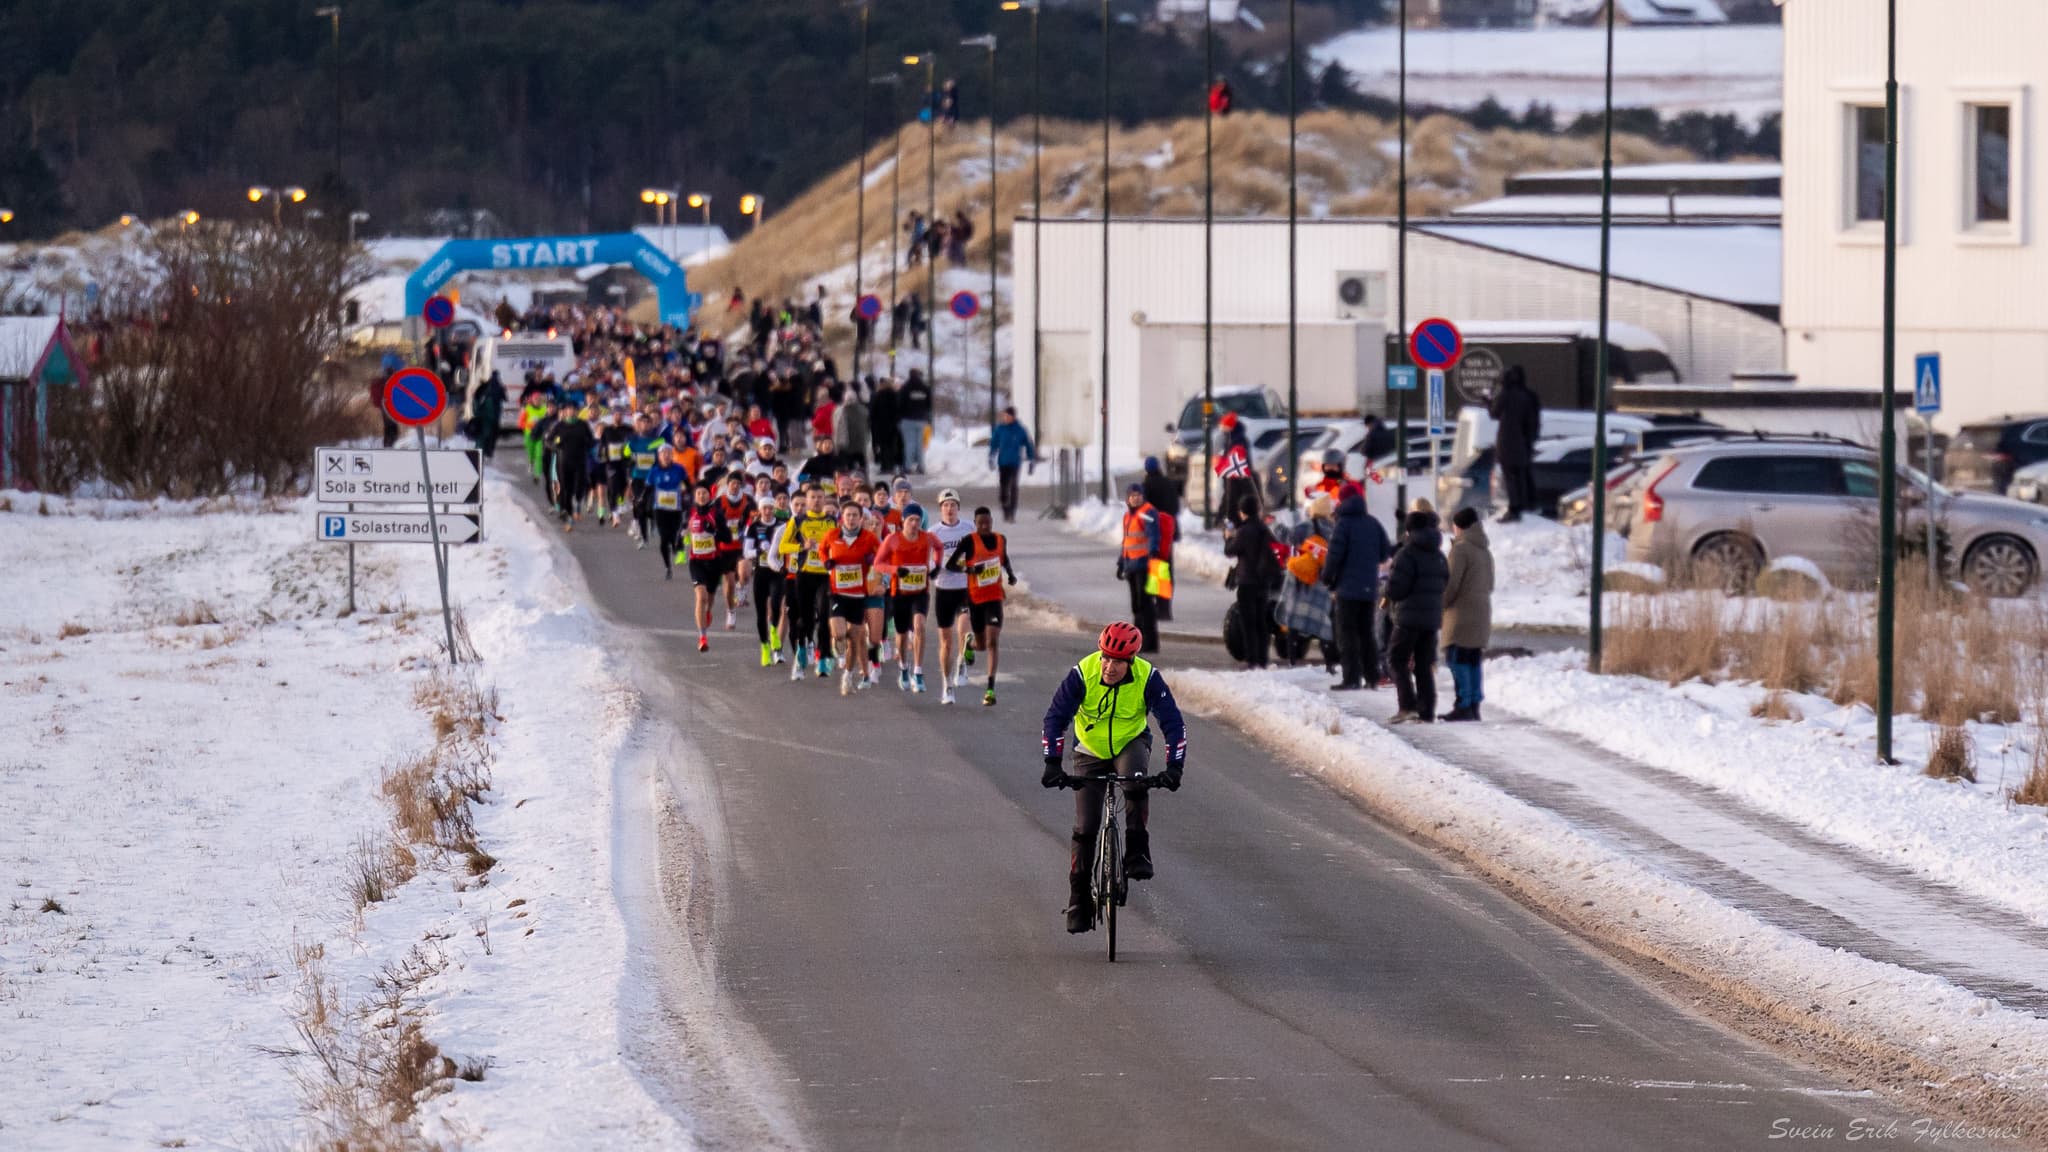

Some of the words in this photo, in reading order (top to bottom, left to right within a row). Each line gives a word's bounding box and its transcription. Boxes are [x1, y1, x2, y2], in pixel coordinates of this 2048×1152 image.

[491, 239, 599, 268] START
[325, 480, 356, 494] Sola
[363, 480, 411, 494] Strand
[351, 520, 448, 535] Solastrandn
